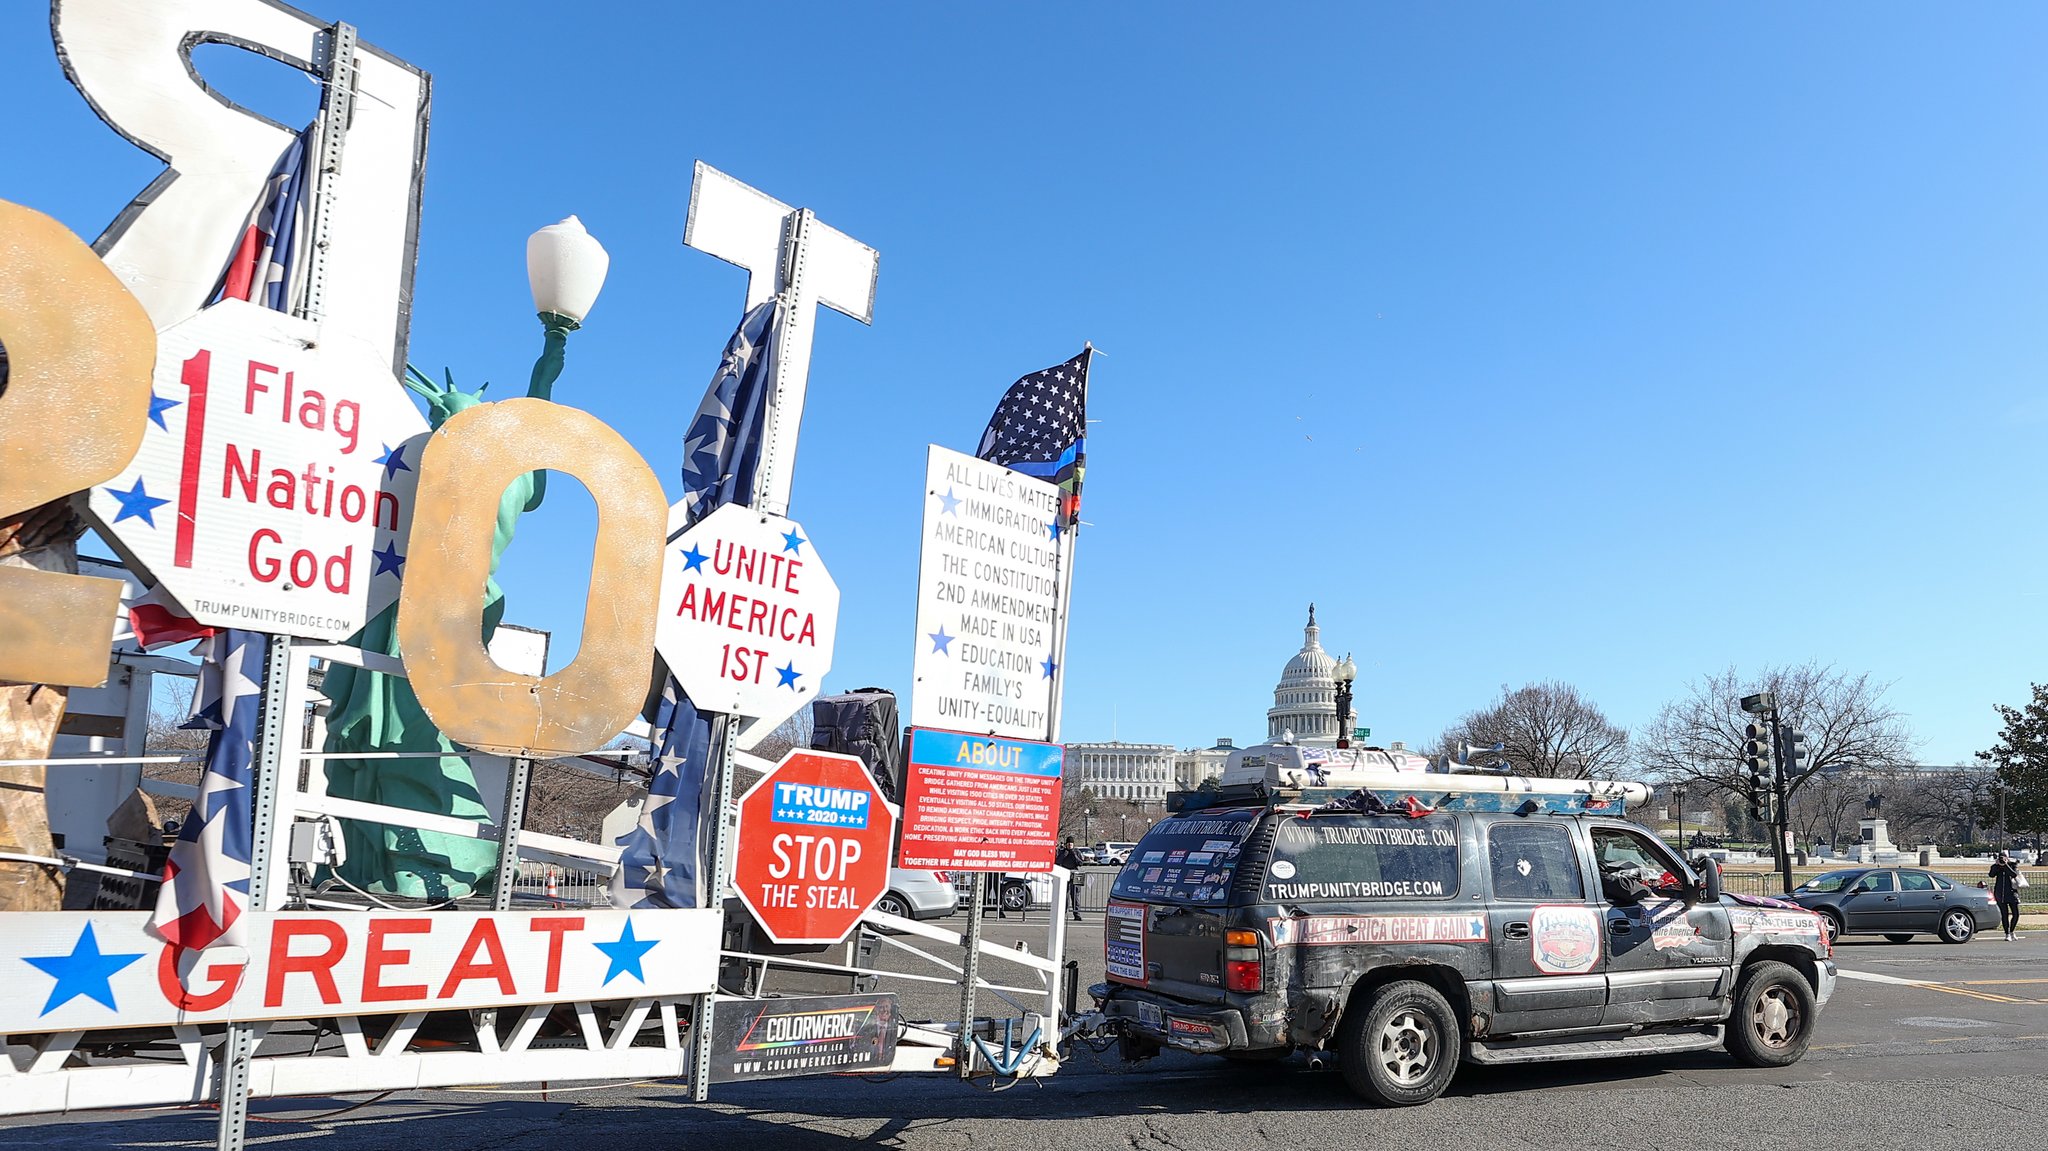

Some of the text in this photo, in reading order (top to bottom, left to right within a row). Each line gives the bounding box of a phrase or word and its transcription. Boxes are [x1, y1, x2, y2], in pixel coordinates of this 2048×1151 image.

[244, 359, 360, 455] Flag
[174, 348, 211, 569] 1
[222, 443, 399, 532] Nation
[947, 462, 1063, 516] ALL LIVES MATTER
[965, 497, 1047, 538] IMMIGRATION
[935, 521, 1062, 573] AMERICAN CULTURE
[248, 528, 353, 596] God
[713, 539, 803, 594] UNITE
[942, 553, 1059, 599] THE CONSTITUTION
[194, 599, 351, 632] TRUMPUNITYBRIDGE.COM
[676, 583, 815, 647] AMERICA
[937, 581, 1056, 625] 2ND AMMENDMENT
[960, 613, 1042, 648] MADE IN USA
[720, 643, 769, 684] 1ST
[961, 643, 1033, 674] EDUCATION
[964, 672, 1023, 699] FAMILY'S
[938, 696, 1044, 730] UNITY-EQUALITY
[956, 741, 1023, 769] ABOUT
[1339, 750, 1408, 766] STAND
[918, 768, 946, 776] CREATING
[979, 774, 1005, 782] MESSAGES
[946, 779, 974, 788] GATHERED
[989, 783, 1017, 792] AMERICANS
[778, 783, 867, 811] TRUMP
[919, 796, 955, 805] EVENTUALLY
[955, 799, 977, 807] VISITING
[946, 789, 969, 797] VISITING
[969, 790, 982, 798] 1500
[807, 809, 838, 824] 2020
[920, 815, 947, 823] BRINGING
[926, 806, 948, 814] REMIND
[923, 834, 958, 843] PRESERVING
[768, 833, 862, 881] STOP
[904, 858, 939, 866] TOGETHER
[939, 859, 950, 867] WE
[950, 859, 963, 867] ARE
[963, 859, 987, 868] MAKING
[987, 860, 1011, 868] AMERICA
[1011, 860, 1029, 868] GREAT
[953, 849, 967, 857] MAY
[980, 850, 998, 858] BLESS
[998, 850, 1010, 858] YOU
[761, 884, 860, 909] THE STEAL
[1268, 881, 1443, 899] TRUMPUNITYBRIDGE.COM
[1291, 917, 1468, 942] MAKE AMERICA GREAT AGAIN
[1642, 915, 1686, 926] Buy American
[1774, 918, 1793, 927] THE
[1795, 919, 1815, 928] USA
[157, 915, 585, 1012] GREAT
[1109, 946, 1140, 966] POLICE
[766, 1013, 855, 1042] COLORWERKZ
[1172, 1021, 1209, 1034] TRUMP 2020
[733, 1051, 871, 1074] WWW.COLORWERKZLED.COM
[766, 1043, 844, 1057] INFINITE COLOR LED
